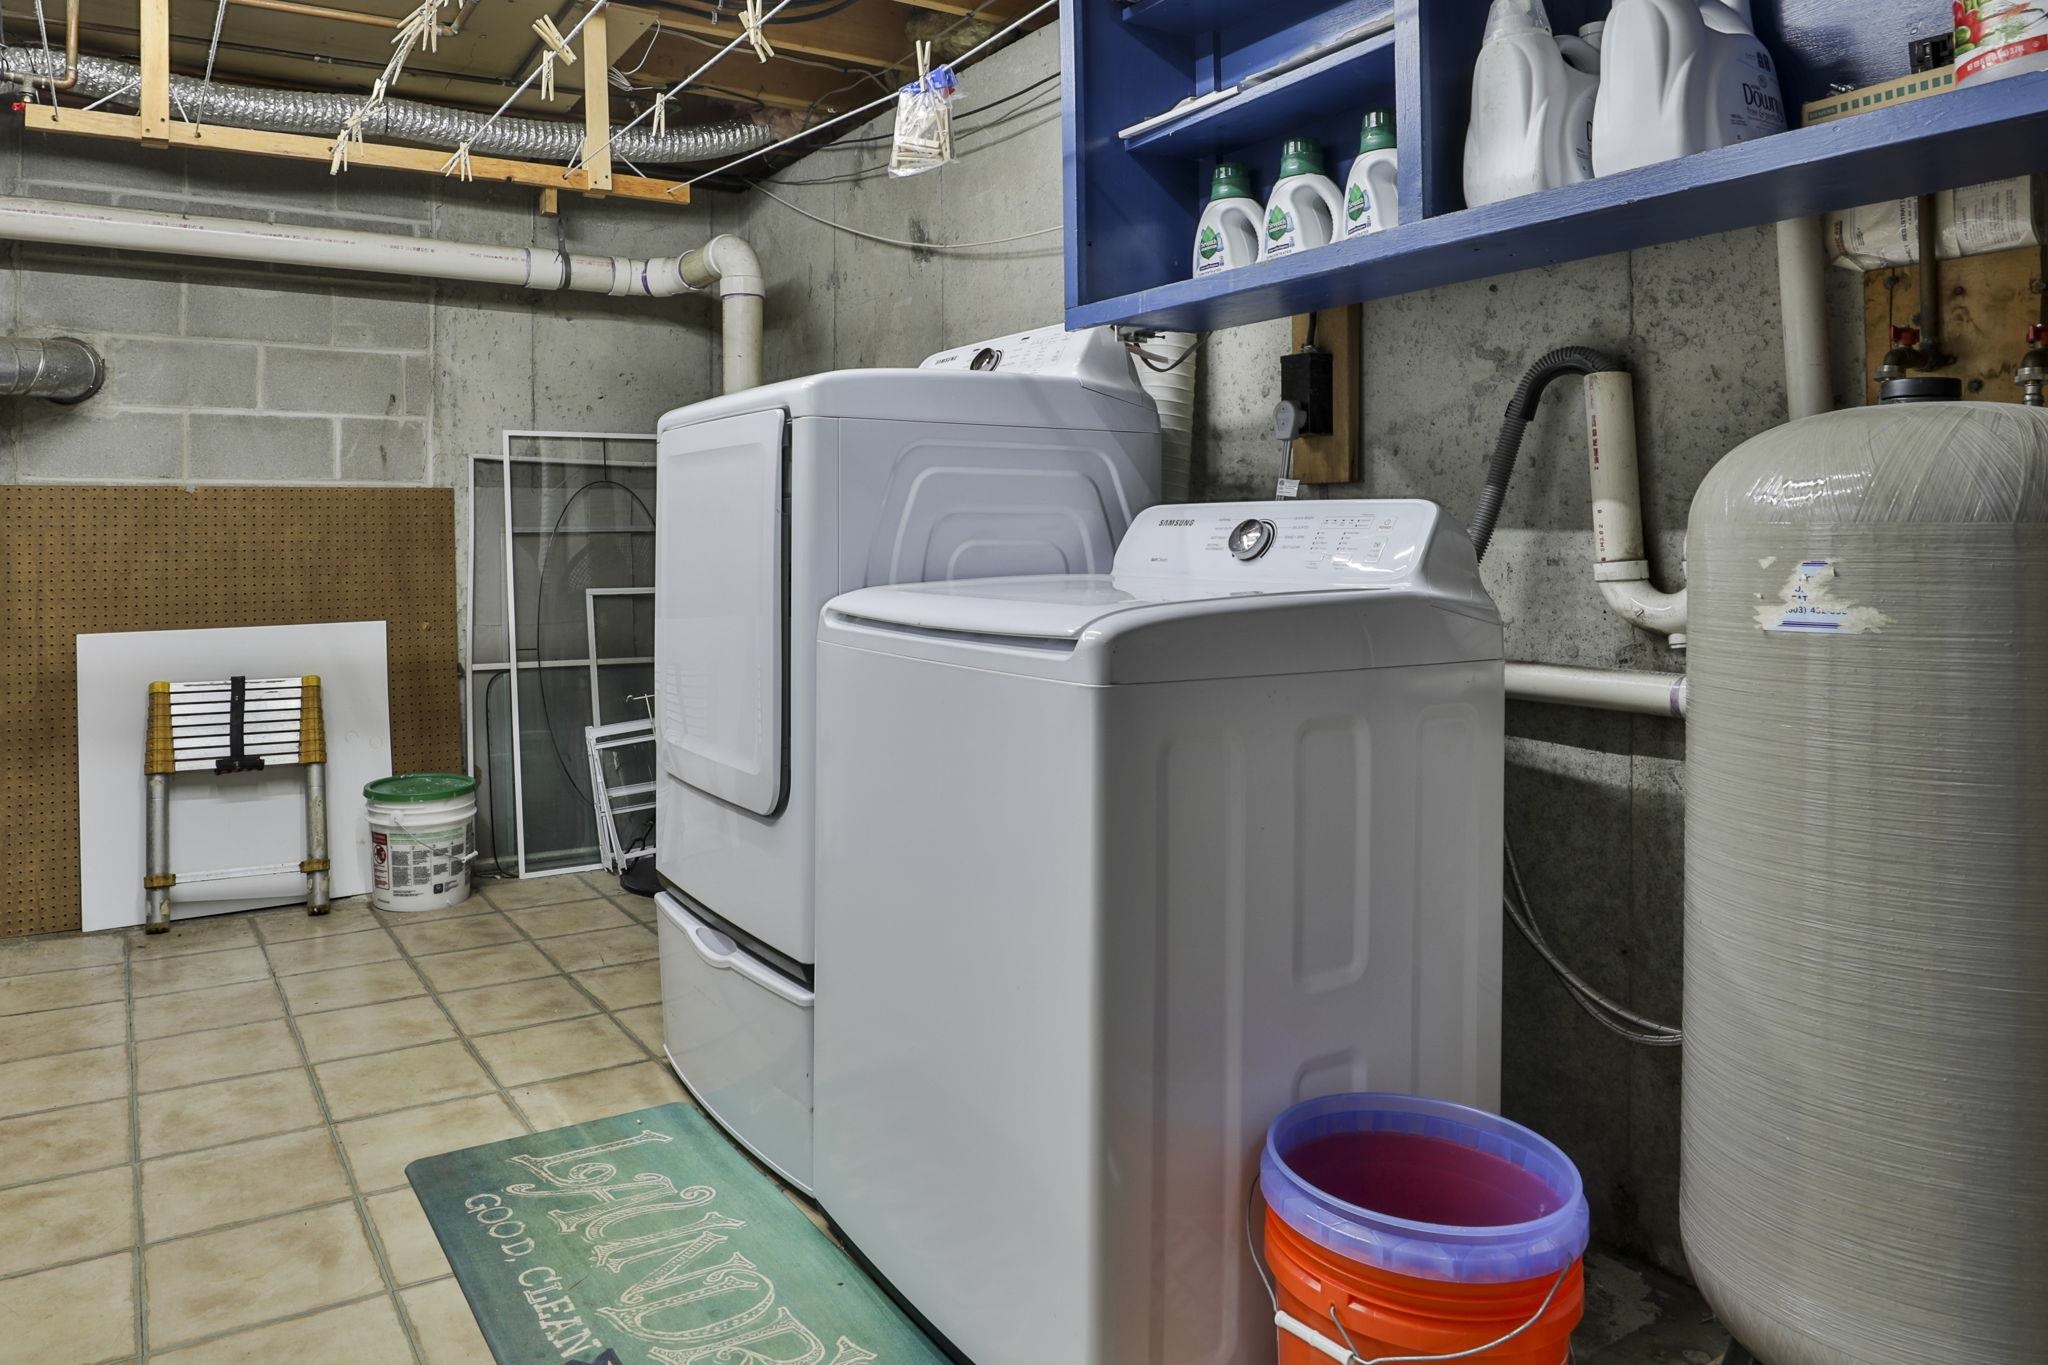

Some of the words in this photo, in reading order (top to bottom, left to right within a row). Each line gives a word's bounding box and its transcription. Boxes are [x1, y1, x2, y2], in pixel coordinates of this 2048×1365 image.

[1158, 519, 1195, 527] SAMSUNG
[464, 1193, 536, 1262] GOOD,
[517, 1265, 604, 1360] CLEAN
[505, 1129, 877, 1365] LAUNDR
